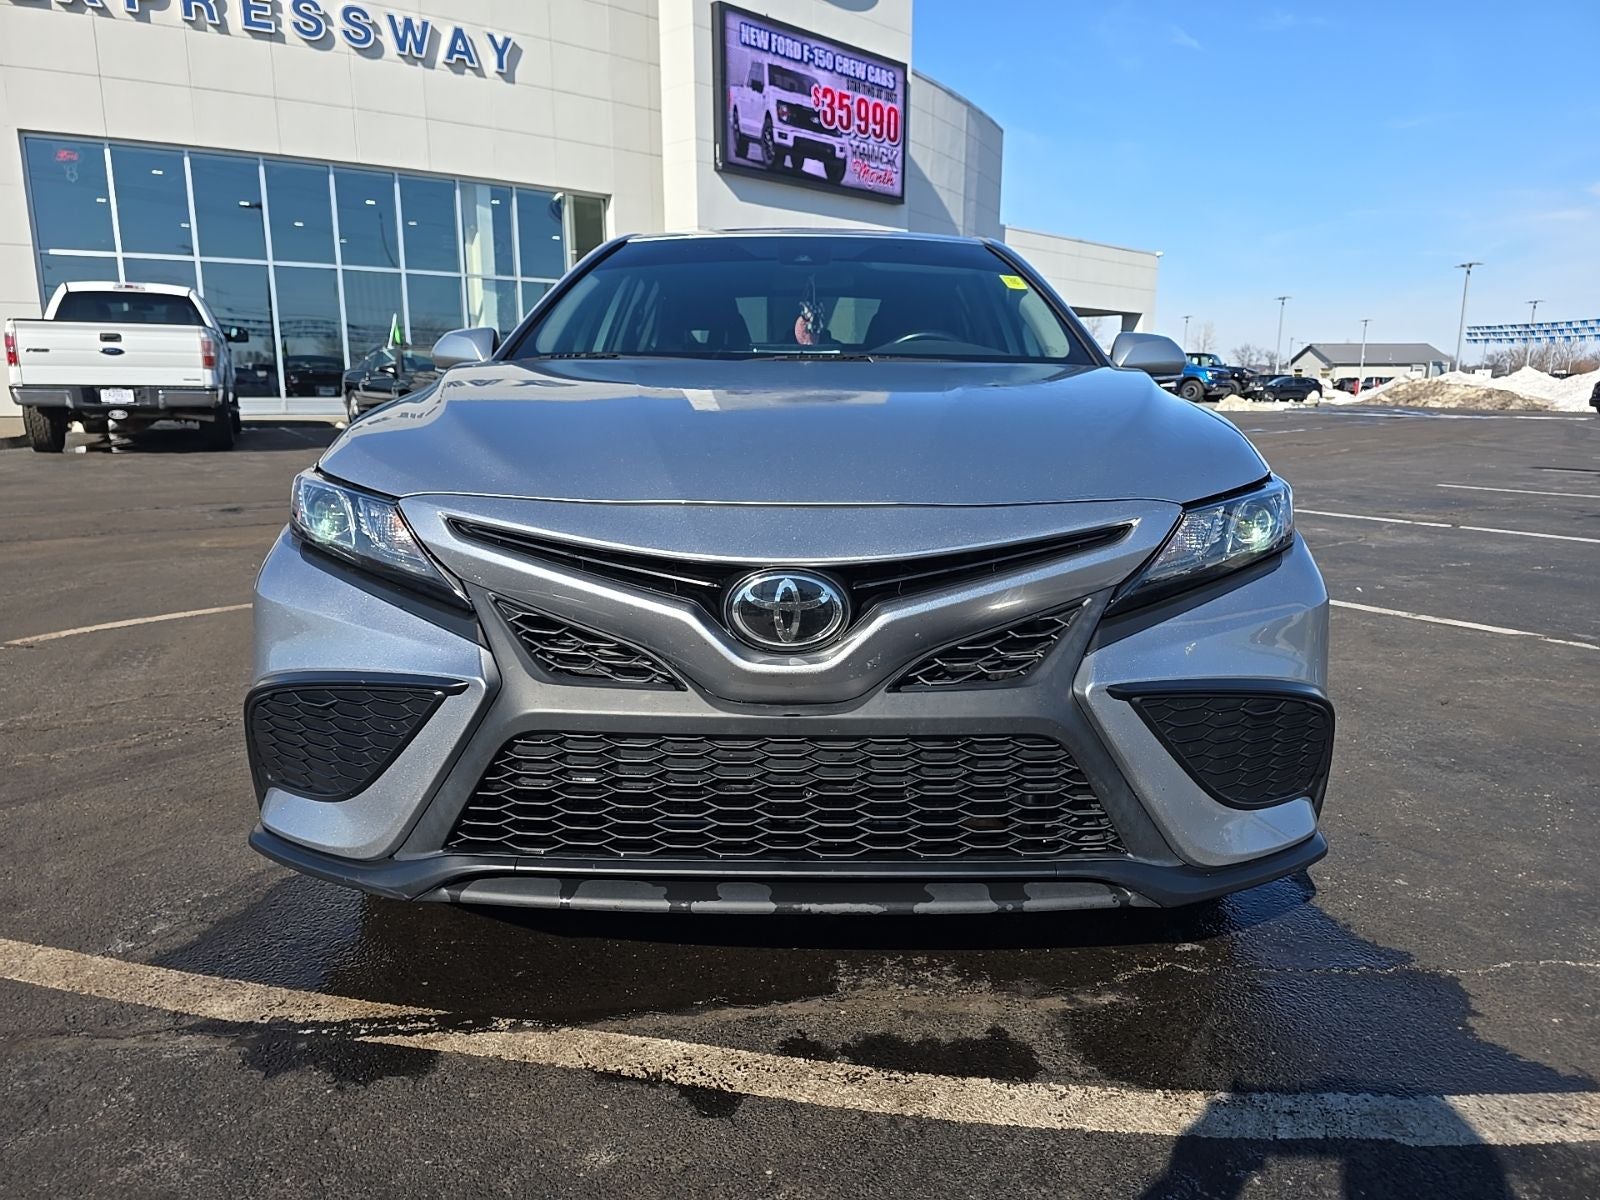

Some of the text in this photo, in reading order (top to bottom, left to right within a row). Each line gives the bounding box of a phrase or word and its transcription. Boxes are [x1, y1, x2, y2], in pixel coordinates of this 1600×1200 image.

[740, 23, 895, 89] NEW FORD F-150 CREW CABS
[849, 139, 898, 172] TRUCK
